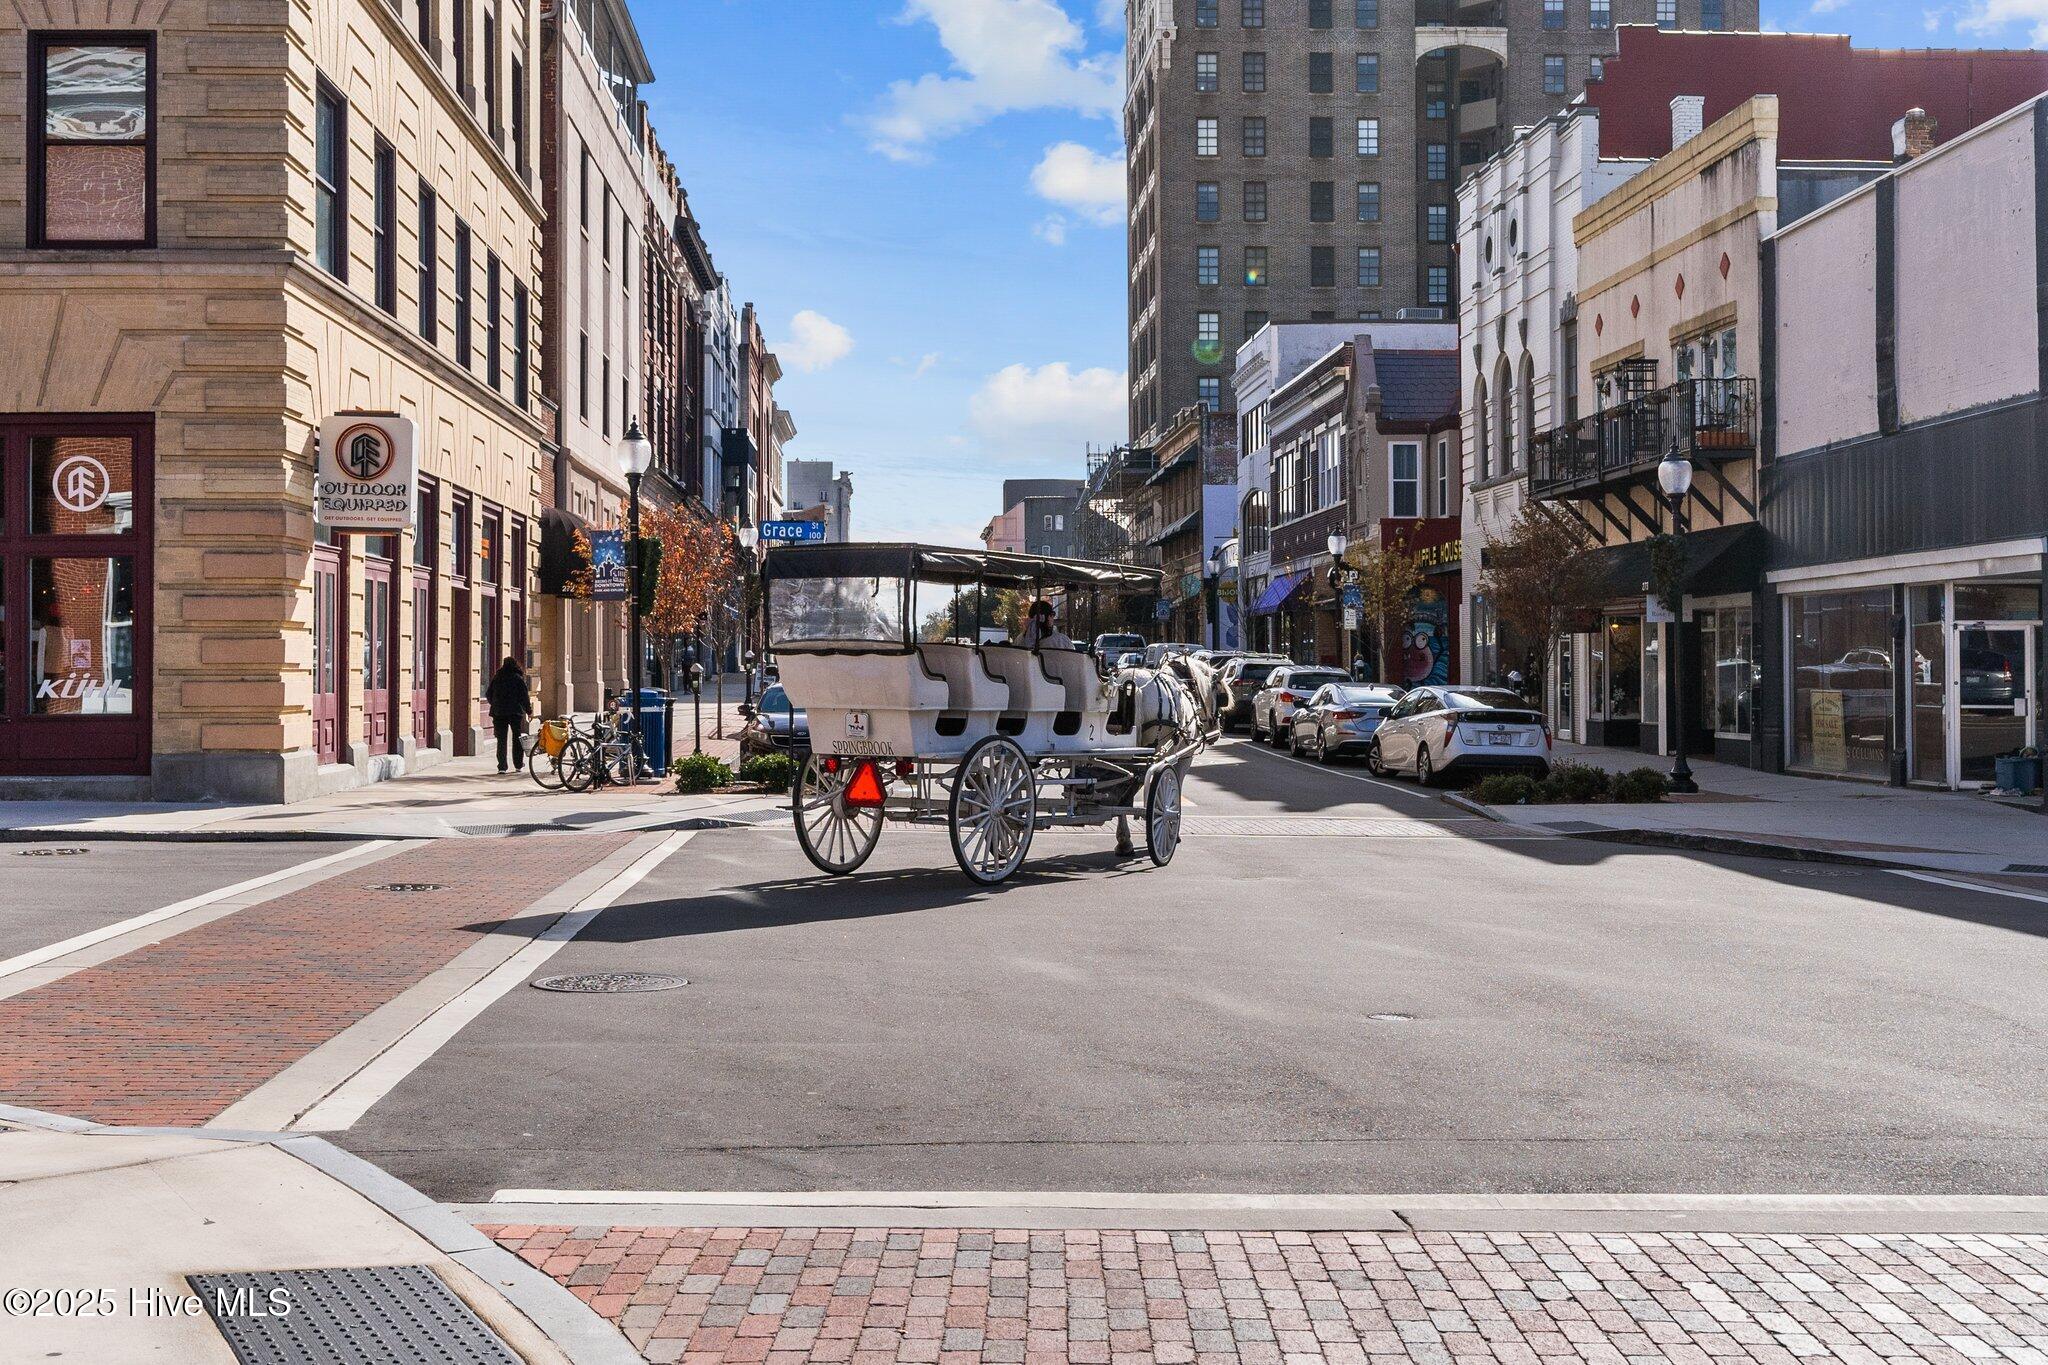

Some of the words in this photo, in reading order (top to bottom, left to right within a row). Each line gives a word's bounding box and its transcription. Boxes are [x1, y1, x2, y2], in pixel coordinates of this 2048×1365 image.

[324, 482, 407, 496] OUTDOOR
[322, 497, 408, 512] EQUIPPED
[763, 523, 803, 537] Grace
[811, 522, 819, 530] St
[809, 531, 822, 539] 100
[36, 672, 127, 699] KÜHL
[854, 714, 859, 724] 1
[832, 740, 894, 755] SPRINGBROOK
